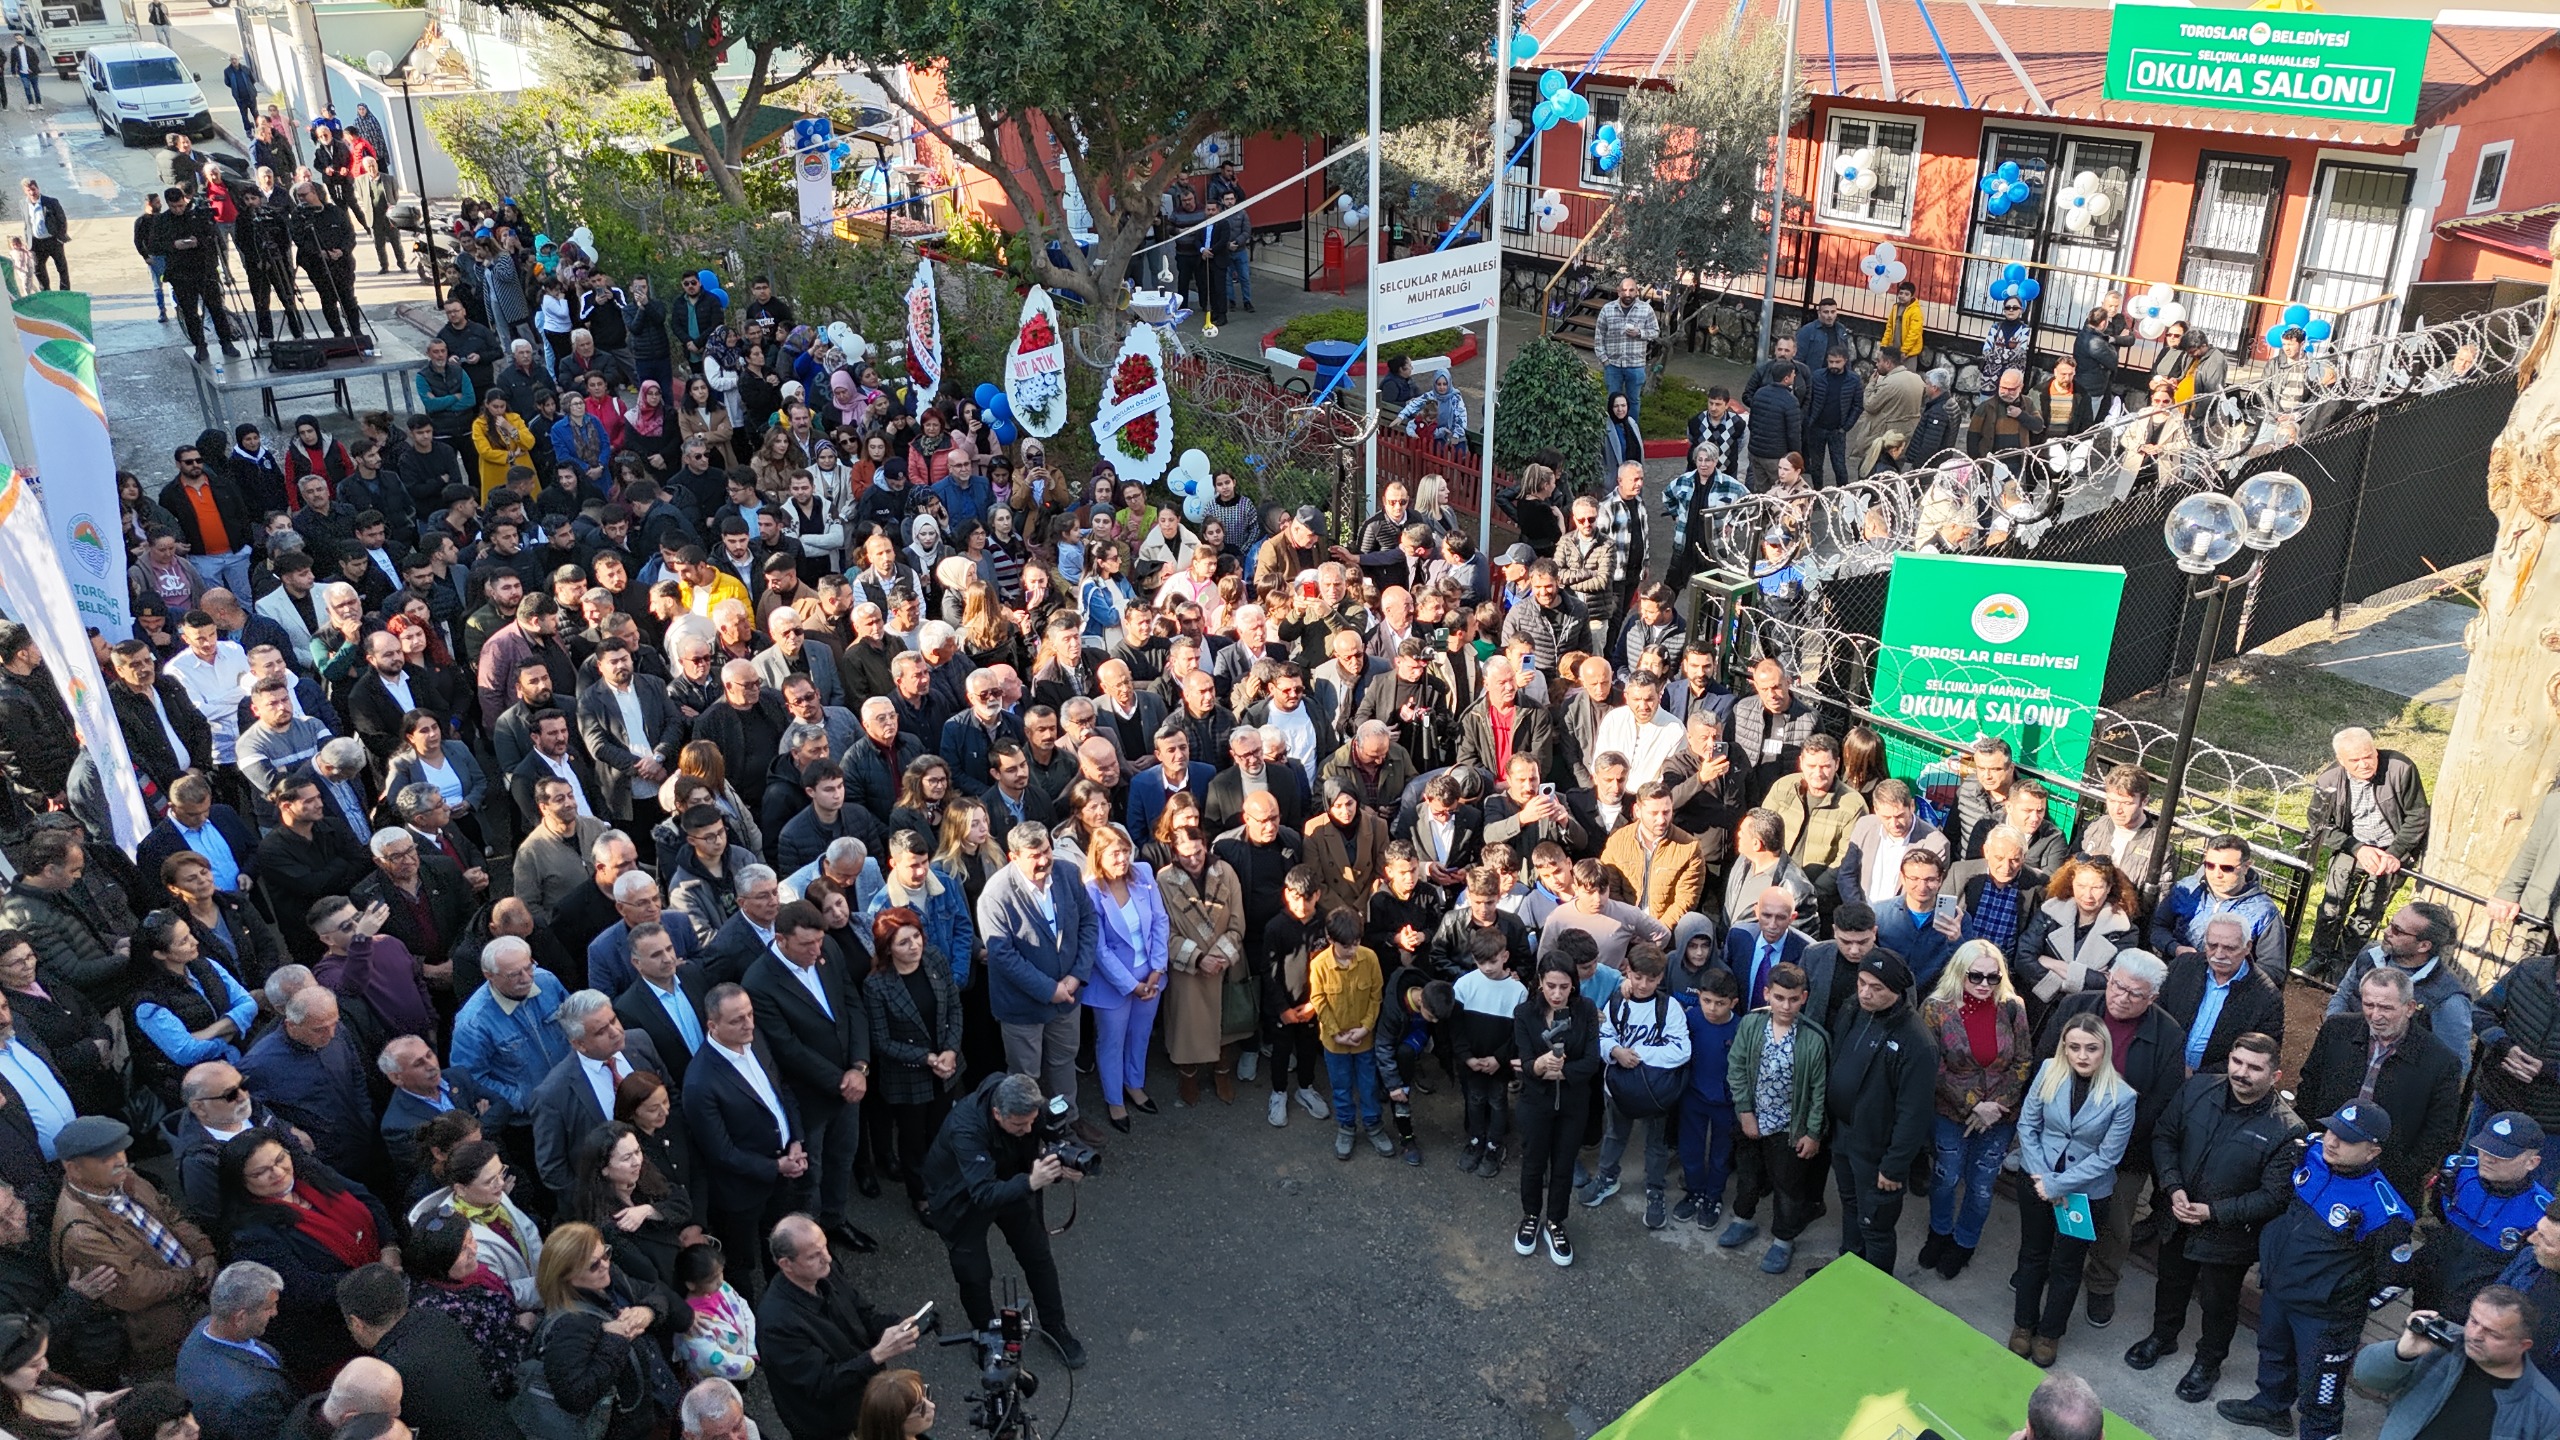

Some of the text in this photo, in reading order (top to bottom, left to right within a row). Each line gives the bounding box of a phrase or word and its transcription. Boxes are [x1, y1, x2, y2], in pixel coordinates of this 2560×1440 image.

[2180, 24, 2350, 48] TOROSLAR BELEDİYESİ
[2198, 50, 2321, 69] SELÇUKLAR MAHALLESİ
[2136, 60, 2383, 105] OKUMA SALONU
[1380, 256, 1497, 294] SELÇUKLAR MAHALLESİ
[1407, 279, 1471, 304] MUHTARLIĞI
[1910, 645, 2079, 670] TOROSLAR BELEDİYESİ
[1925, 679, 2051, 700] SELÇUKLAR MAHALLESİ
[1900, 694, 2071, 728] OKUMA SALONU
